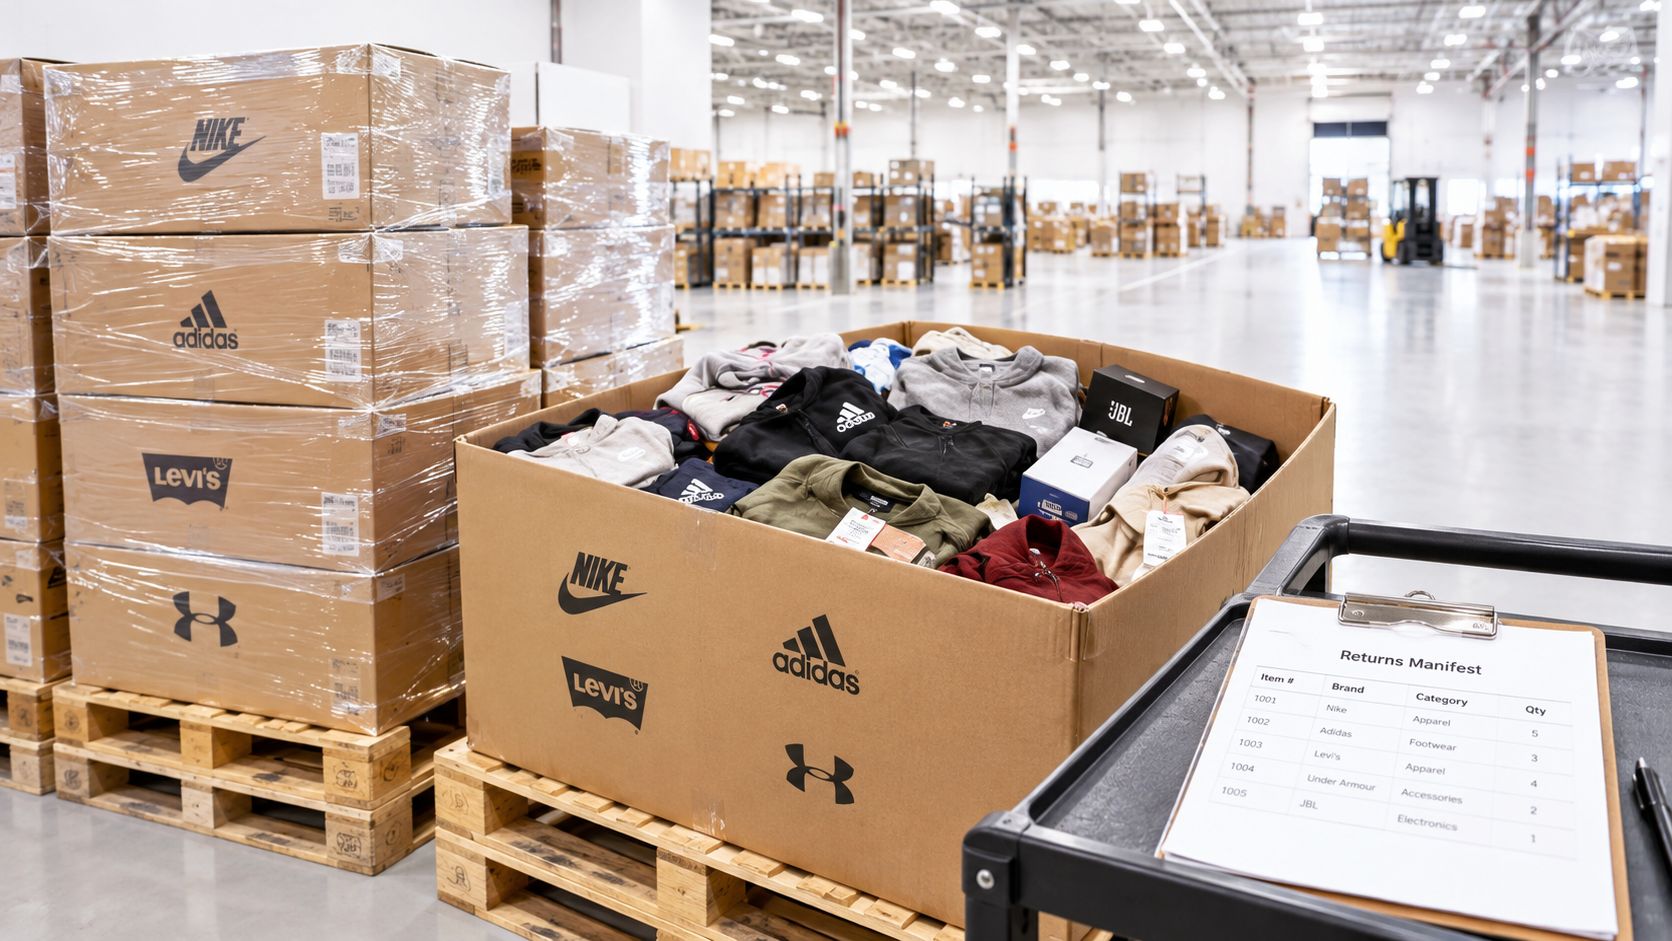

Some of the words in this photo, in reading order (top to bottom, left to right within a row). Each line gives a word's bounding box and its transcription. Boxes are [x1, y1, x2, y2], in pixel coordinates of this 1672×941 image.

[191, 116, 246, 152] NIKE
[172, 328, 238, 350] adidas
[1108, 400, 1133, 427] JBL
[571, 551, 629, 596] NIKE
[772, 650, 860, 696] adidas
[1340, 650, 1403, 666] Returns
[1409, 658, 1482, 675] Manifest
[1255, 695, 1276, 704] 1001
[1327, 704, 1347, 713] Nike
[1413, 716, 1450, 726] Apparel
[1531, 729, 1539, 738] 5
[1261, 673, 1284, 683] Item
[1287, 676, 1295, 685] #
[1332, 682, 1365, 694] Brand
[1416, 693, 1468, 707] Category
[1526, 705, 1546, 716] Qty
[1248, 716, 1270, 725] 1002
[1320, 728, 1352, 737] Adidas
[1409, 738, 1456, 751] Footwear
[1530, 753, 1539, 763] 3
[1240, 739, 1263, 748] 1003
[1314, 750, 1340, 760] Levi's
[1405, 763, 1445, 775] Apparel
[1529, 779, 1538, 788] 4
[1232, 762, 1254, 772] 1004
[1307, 775, 1336, 785] Under
[1339, 779, 1375, 790] Armour
[1401, 789, 1462, 804] Accessories
[1530, 805, 1538, 816] 2
[1222, 787, 1247, 797] 1005
[1300, 800, 1318, 809] JBL
[1398, 814, 1457, 831] Electronics
[1531, 833, 1536, 844] 1
